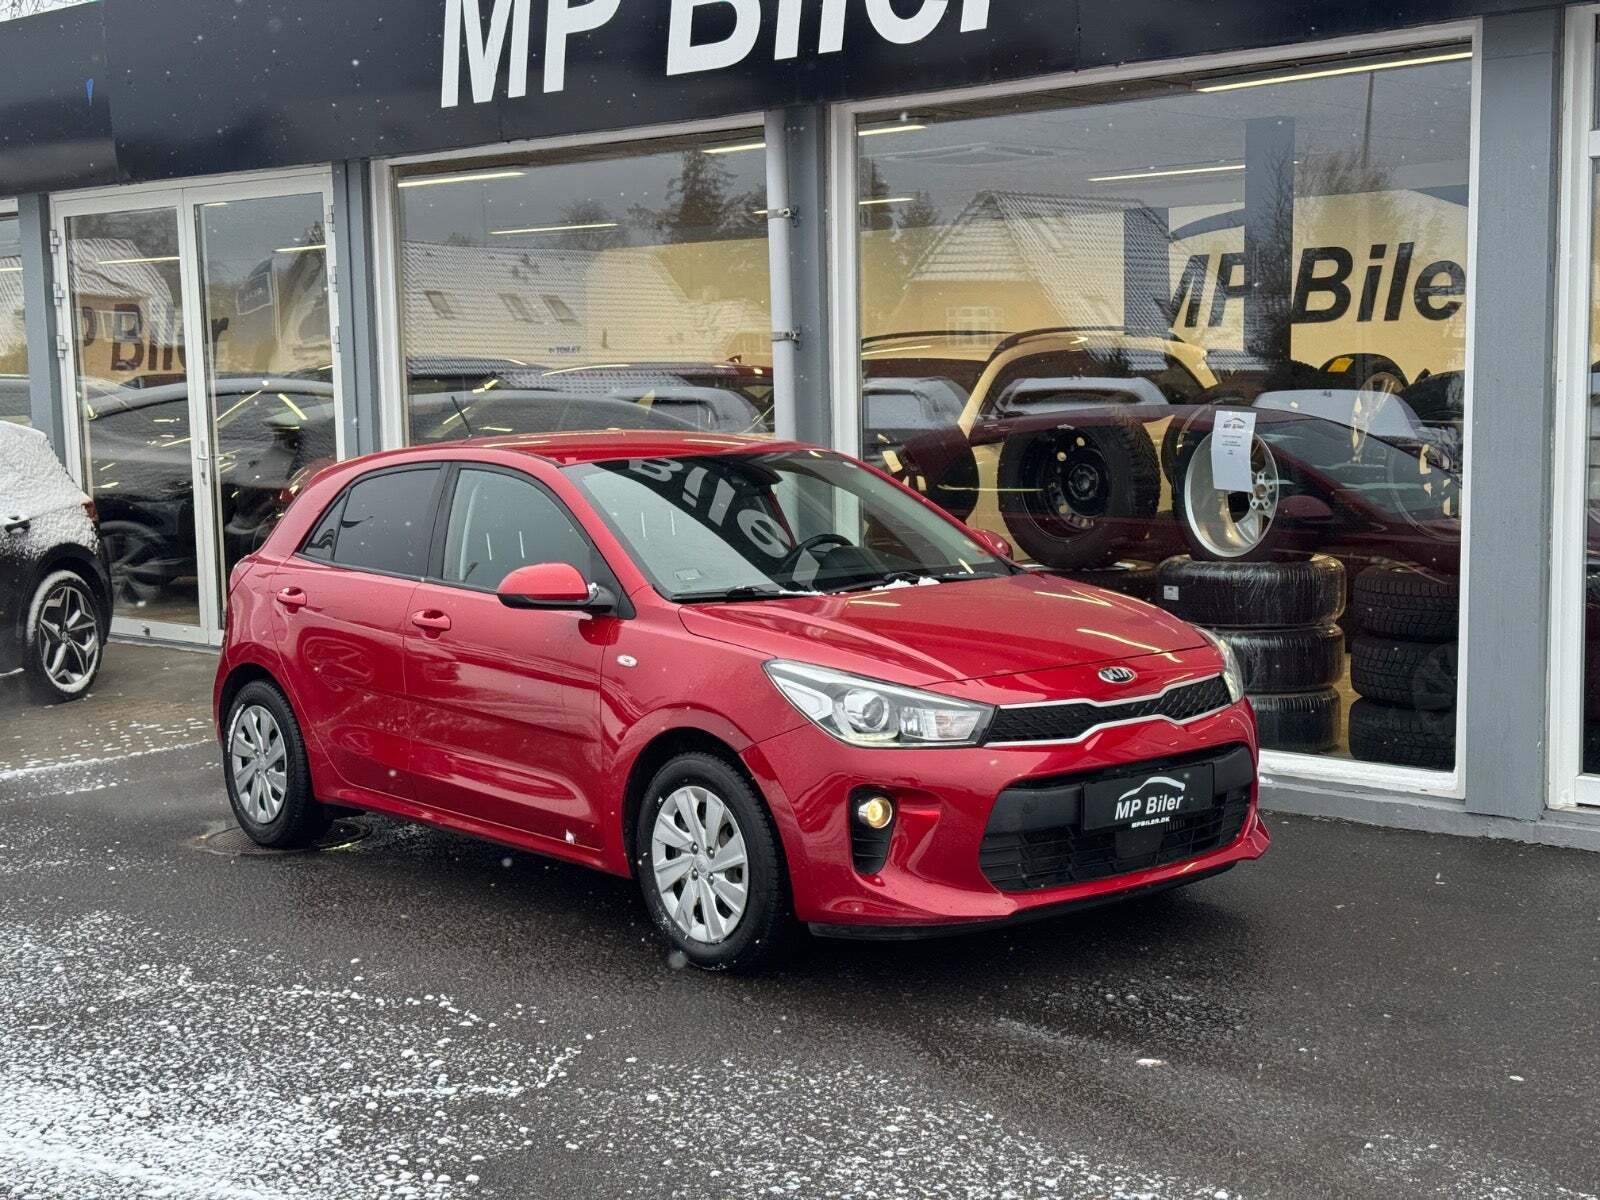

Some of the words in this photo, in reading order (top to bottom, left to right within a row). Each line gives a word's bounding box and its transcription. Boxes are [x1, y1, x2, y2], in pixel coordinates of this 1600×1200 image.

[440, 0, 619, 108] MP
[1102, 668, 1133, 680] KIA
[1114, 799, 1142, 820] MP
[1145, 794, 1184, 815] Biler
